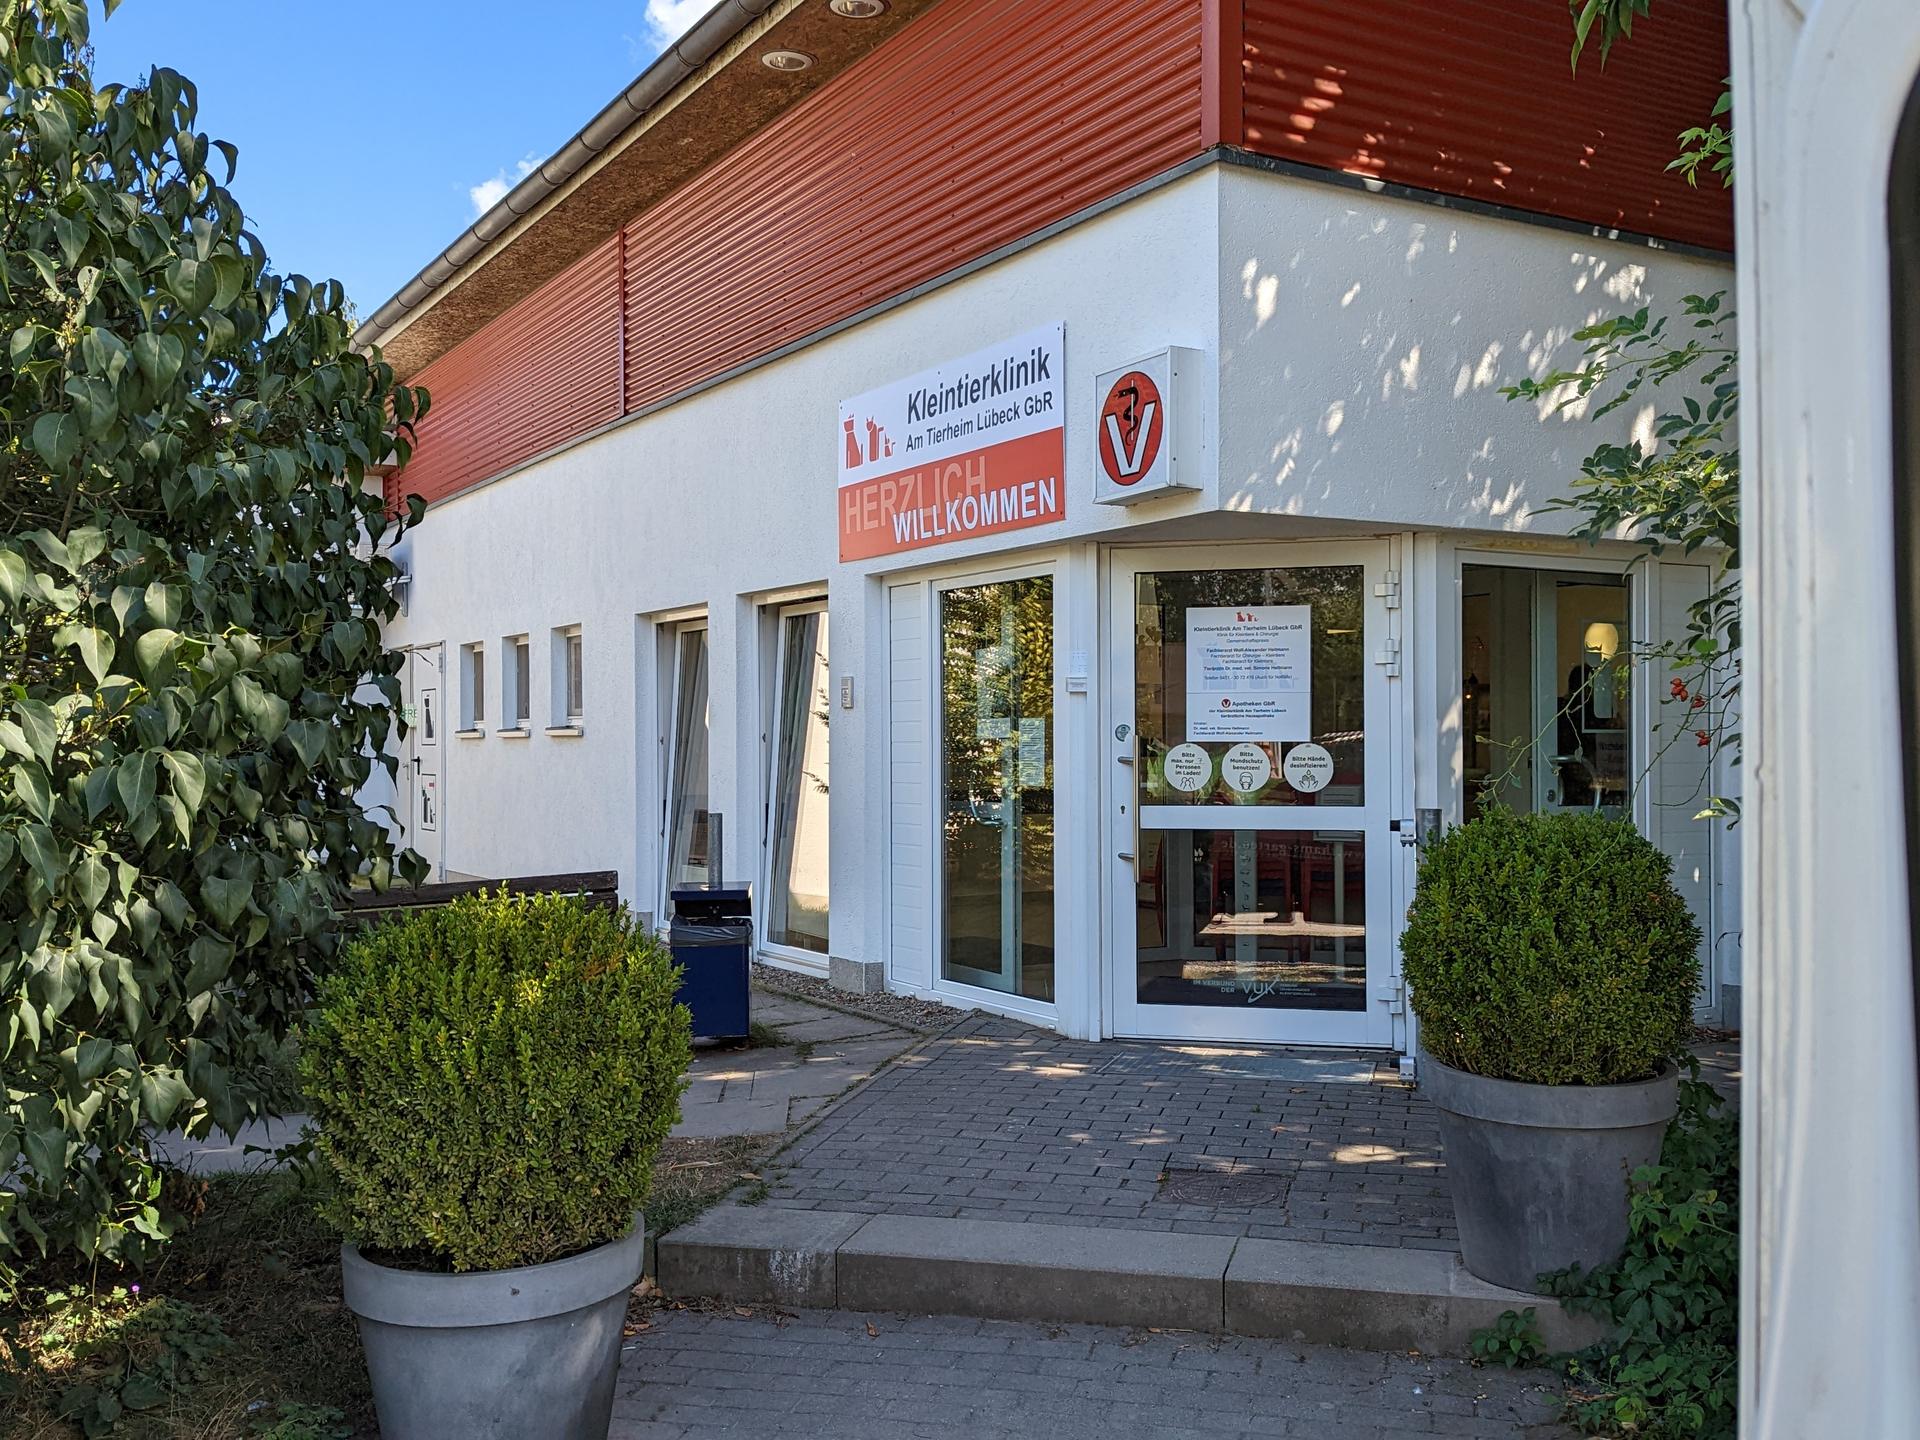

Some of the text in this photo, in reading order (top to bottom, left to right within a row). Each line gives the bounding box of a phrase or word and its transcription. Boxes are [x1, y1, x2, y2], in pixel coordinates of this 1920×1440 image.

[907, 346, 1051, 425] Kleintierklinik
[906, 390, 1054, 453] Am Tierheim Lübeck GbR
[844, 455, 986, 535] HERZLICH
[892, 476, 1056, 545] WILLKOMMEN
[1268, 624, 1288, 632] Lübeck
